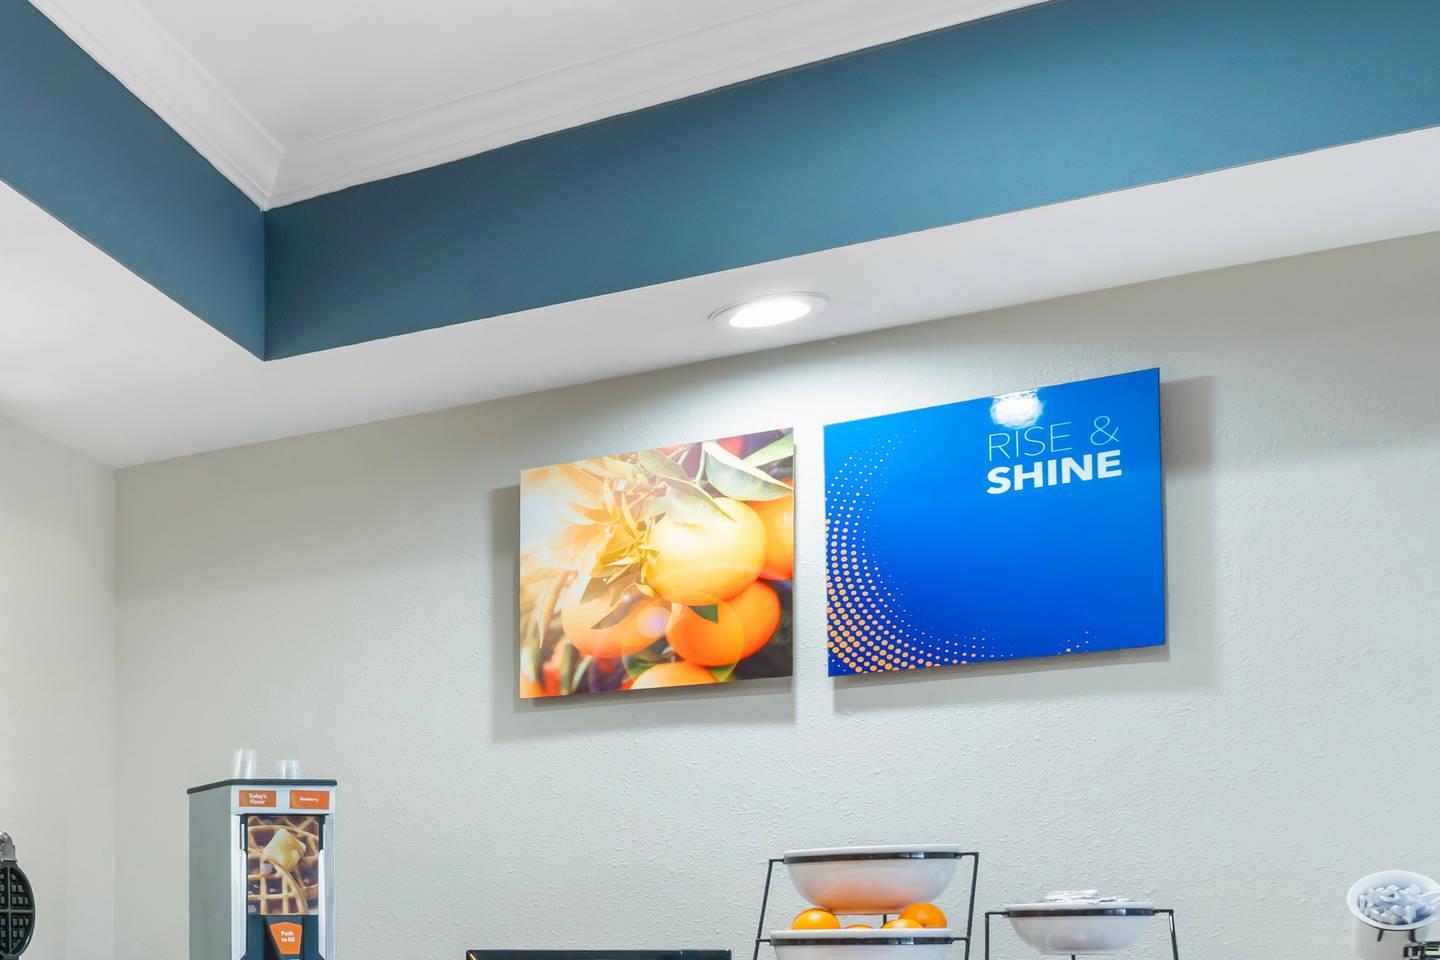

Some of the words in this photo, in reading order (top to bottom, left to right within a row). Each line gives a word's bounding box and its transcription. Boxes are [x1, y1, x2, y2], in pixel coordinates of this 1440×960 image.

[988, 421, 1073, 462] RISE
[1090, 415, 1120, 446] &
[986, 449, 1122, 495] SHINE
